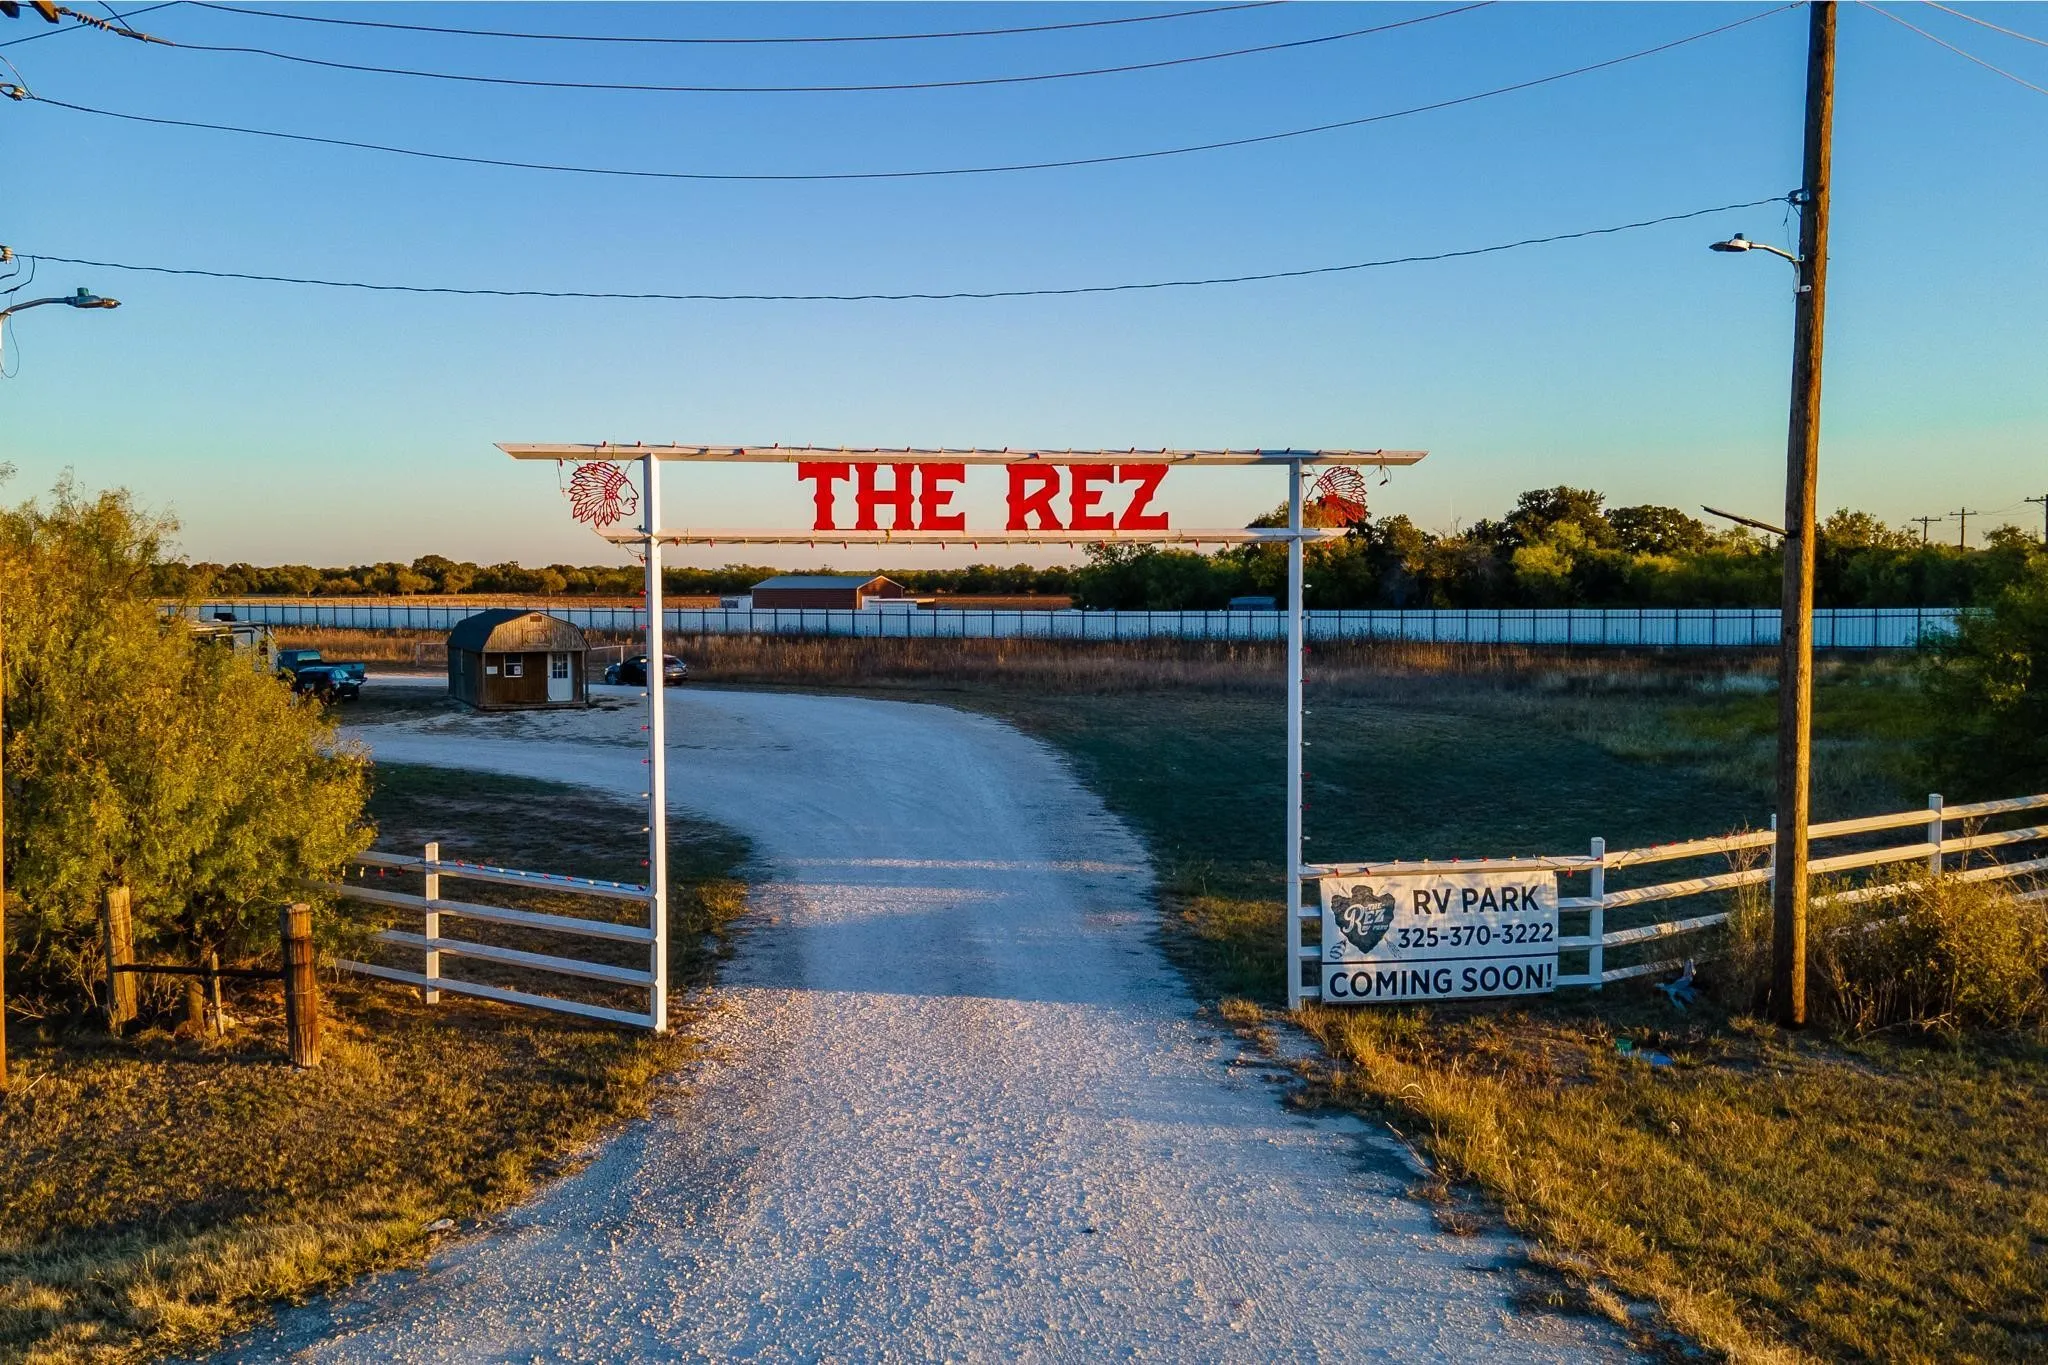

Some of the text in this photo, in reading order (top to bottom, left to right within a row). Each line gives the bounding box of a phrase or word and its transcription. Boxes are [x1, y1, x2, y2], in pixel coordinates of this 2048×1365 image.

[798, 461, 1168, 531] THE REZ
[1412, 885, 1541, 916] RV PARK
[1397, 921, 1554, 949] 325-370-3222
[1329, 963, 1553, 997] COMING SOON!
